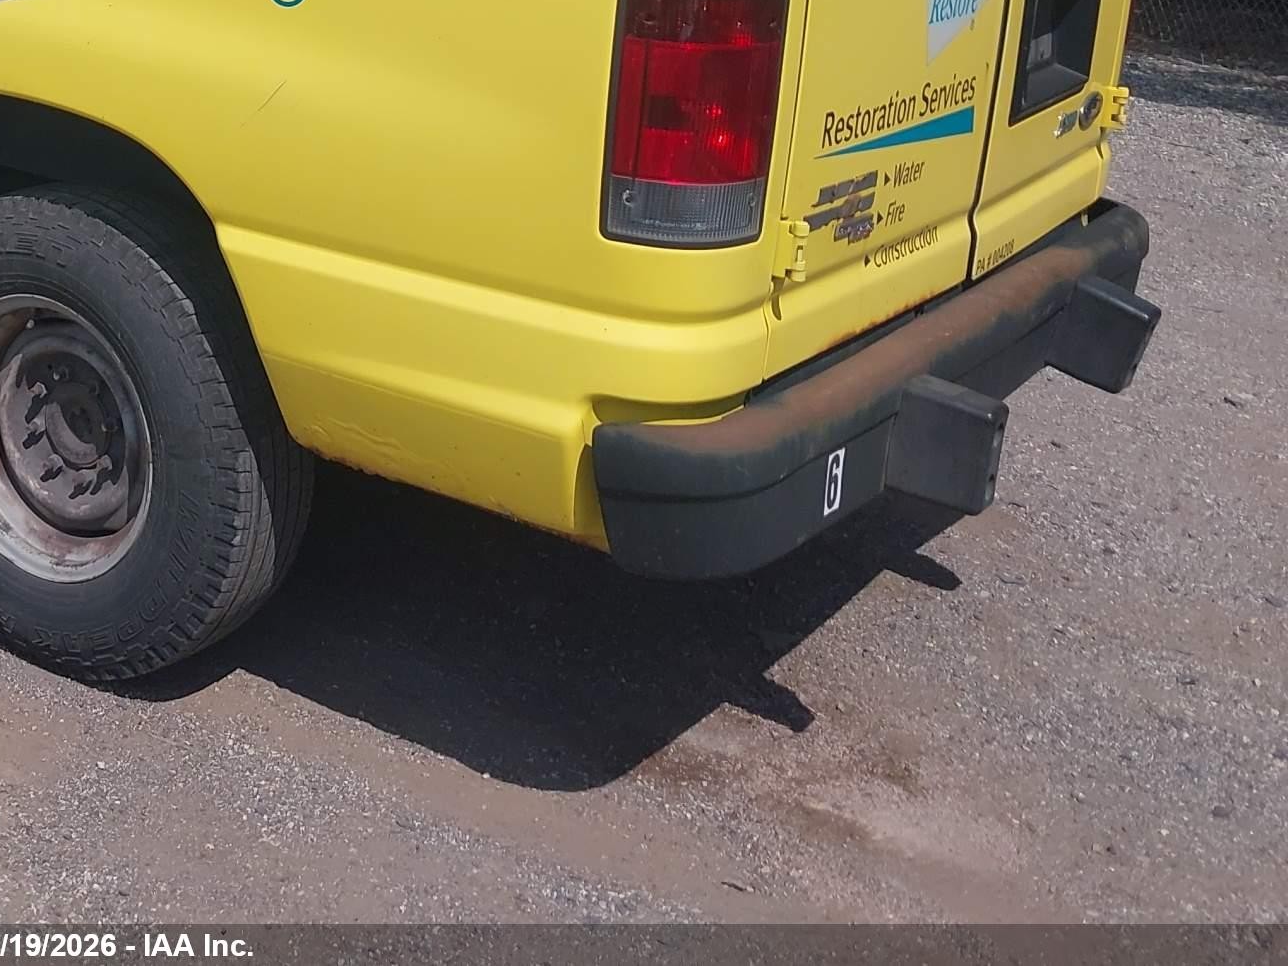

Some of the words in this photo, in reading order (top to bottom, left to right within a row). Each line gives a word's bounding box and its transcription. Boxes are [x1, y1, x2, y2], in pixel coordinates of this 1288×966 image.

[821, 90, 916, 149] Restoration
[919, 74, 977, 117] Services
[893, 161, 925, 188] Water
[885, 200, 906, 226] Fire
[873, 225, 939, 268] Construction
[826, 453, 841, 510] 6
